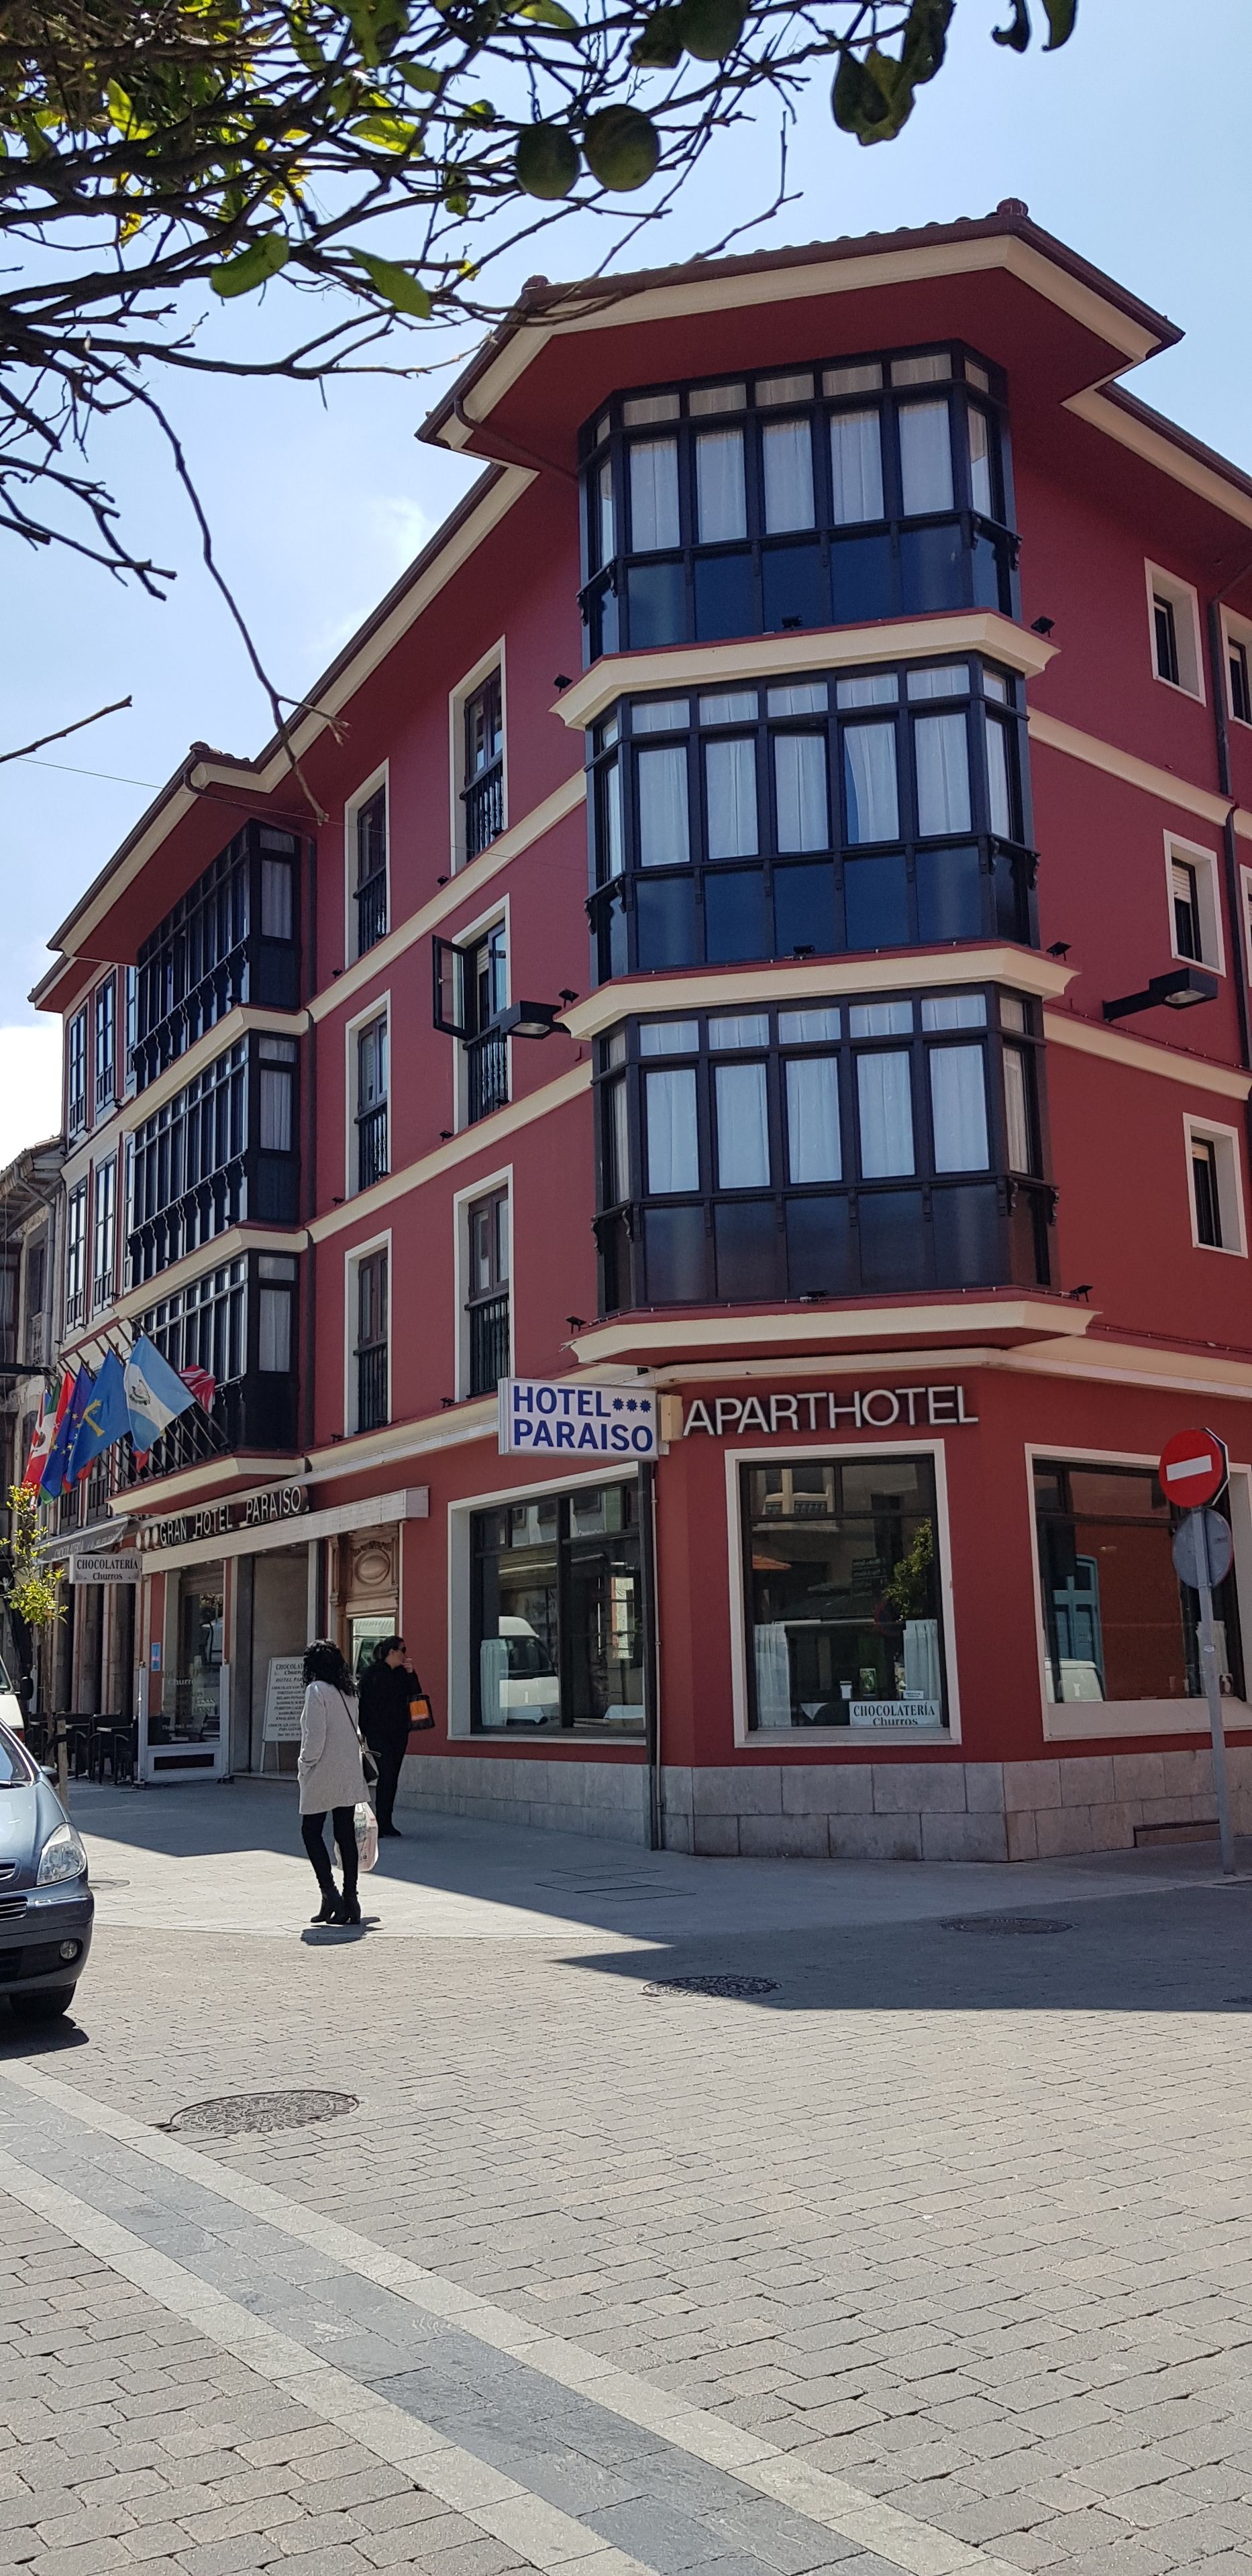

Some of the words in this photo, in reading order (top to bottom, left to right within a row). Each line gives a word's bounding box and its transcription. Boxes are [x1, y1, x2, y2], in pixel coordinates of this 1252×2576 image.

[513, 1385, 611, 1417] HOTEL
[682, 1385, 979, 1437] APARTHOTEL
[513, 1418, 654, 1452] PARAISO
[160, 1517, 187, 1545] GRAN
[195, 1504, 233, 1538] HOTEL
[246, 1486, 301, 1523] PARAISO
[76, 1558, 138, 1570] CHOCOLATERÍA
[93, 1572, 123, 1580] Churros
[853, 1702, 935, 1717] CHOCOLATERÍA
[873, 1717, 919, 1726] Churros
